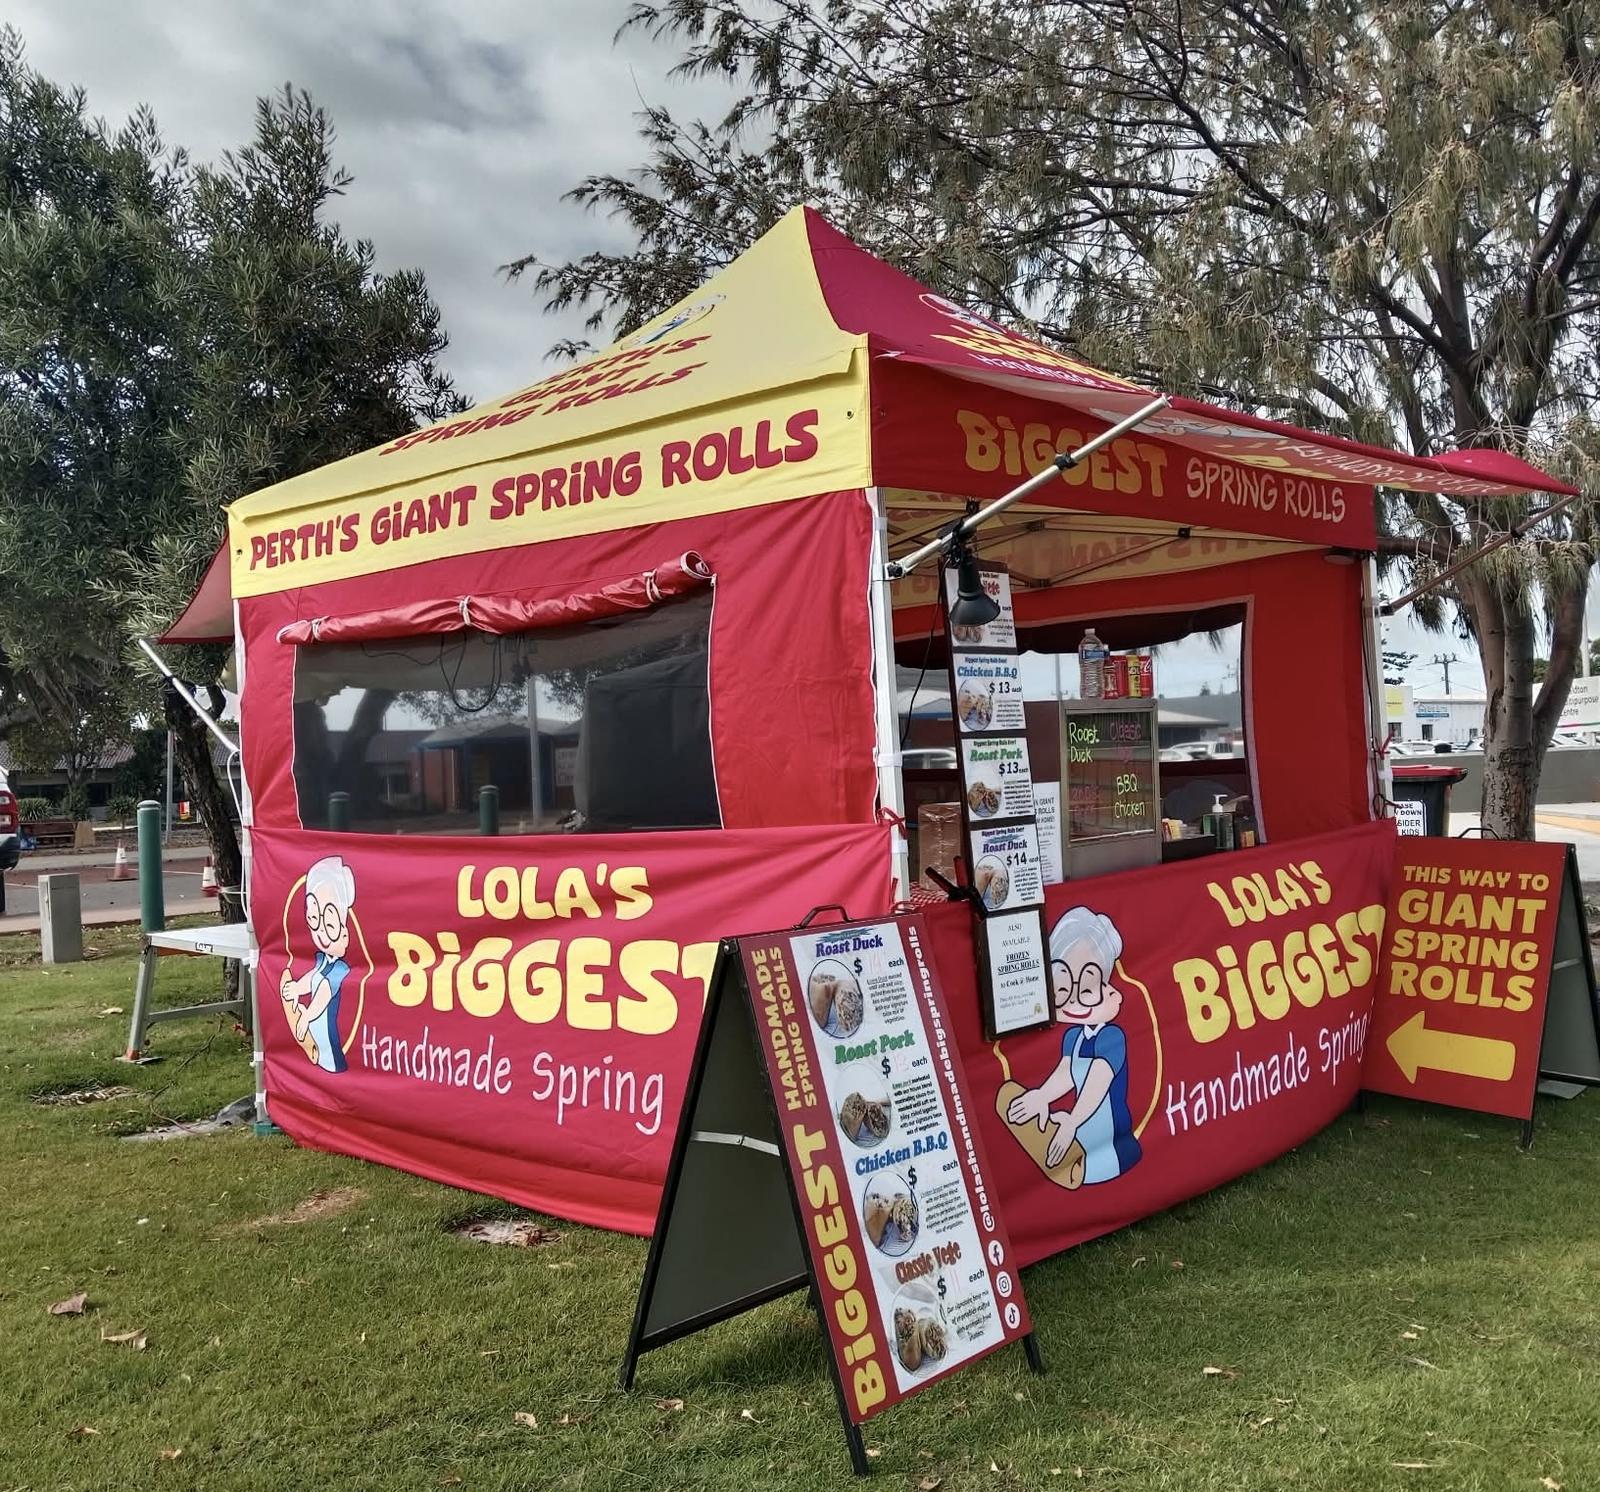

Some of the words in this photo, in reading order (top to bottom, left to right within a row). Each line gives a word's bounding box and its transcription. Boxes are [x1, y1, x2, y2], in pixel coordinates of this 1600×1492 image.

[542, 361, 708, 415] ROLLS
[249, 512, 360, 571] PERTH'S
[660, 409, 819, 487] ROLLS
[1185, 456, 1278, 511] SPRING
[1282, 475, 1346, 524] ROLLS
[958, 666, 994, 677] Chicken
[995, 667, 1018, 679] B.B.Q
[970, 750, 999, 761] Roast
[1000, 748, 1022, 760] Pork
[1071, 746, 1093, 763] Duck
[1116, 773, 1138, 795] BBQ
[1114, 800, 1145, 818] Chicken
[983, 843, 1006, 853] Roast
[1008, 840, 1027, 850] Duck
[457, 862, 654, 921] LOLA'S
[1206, 860, 1332, 927] LOLA'S
[1404, 865, 1453, 885] THIS
[1459, 868, 1512, 889] WAY
[1518, 872, 1550, 893] TO
[1008, 923, 1022, 931] ALSO
[1398, 888, 1548, 935] GIANT
[815, 942, 850, 958] Roast
[853, 935, 883, 951] Duck
[1002, 937, 1030, 947] AVAILABLE
[1006, 951, 1029, 961] FROZEN
[1391, 928, 1539, 972] SPRING
[769, 946, 796, 1016] ROLLS
[854, 957, 863, 976] $
[888, 958, 904, 967] each
[998, 963, 1020, 974] SPRING
[1020, 959, 1040, 970] ROLLS
[1006, 980, 1019, 988] Cook
[1389, 960, 1536, 1013] ROLLS
[751, 948, 802, 1111] HANDMADE
[835, 1040, 877, 1064] Roast
[879, 1029, 915, 1053] Pork
[362, 1024, 512, 1095] Handmade
[532, 1051, 664, 1135] Spring
[787, 1021, 817, 1107] SPRING
[881, 1056, 891, 1079] $
[912, 1056, 927, 1067] each
[908, 926, 995, 1233] @lolashandmadebigspringrolls
[1165, 1031, 1310, 1136] Handmade
[1318, 1011, 1368, 1086] Spring
[855, 1147, 910, 1176] Chicken
[913, 1131, 948, 1157] B.B.Q
[908, 1165, 917, 1189] $
[942, 1160, 958, 1171] each
[896, 1252, 933, 1284] Classic
[932, 1241, 961, 1268] Vege
[937, 1275, 947, 1300] $
[969, 1269, 984, 1282] each
